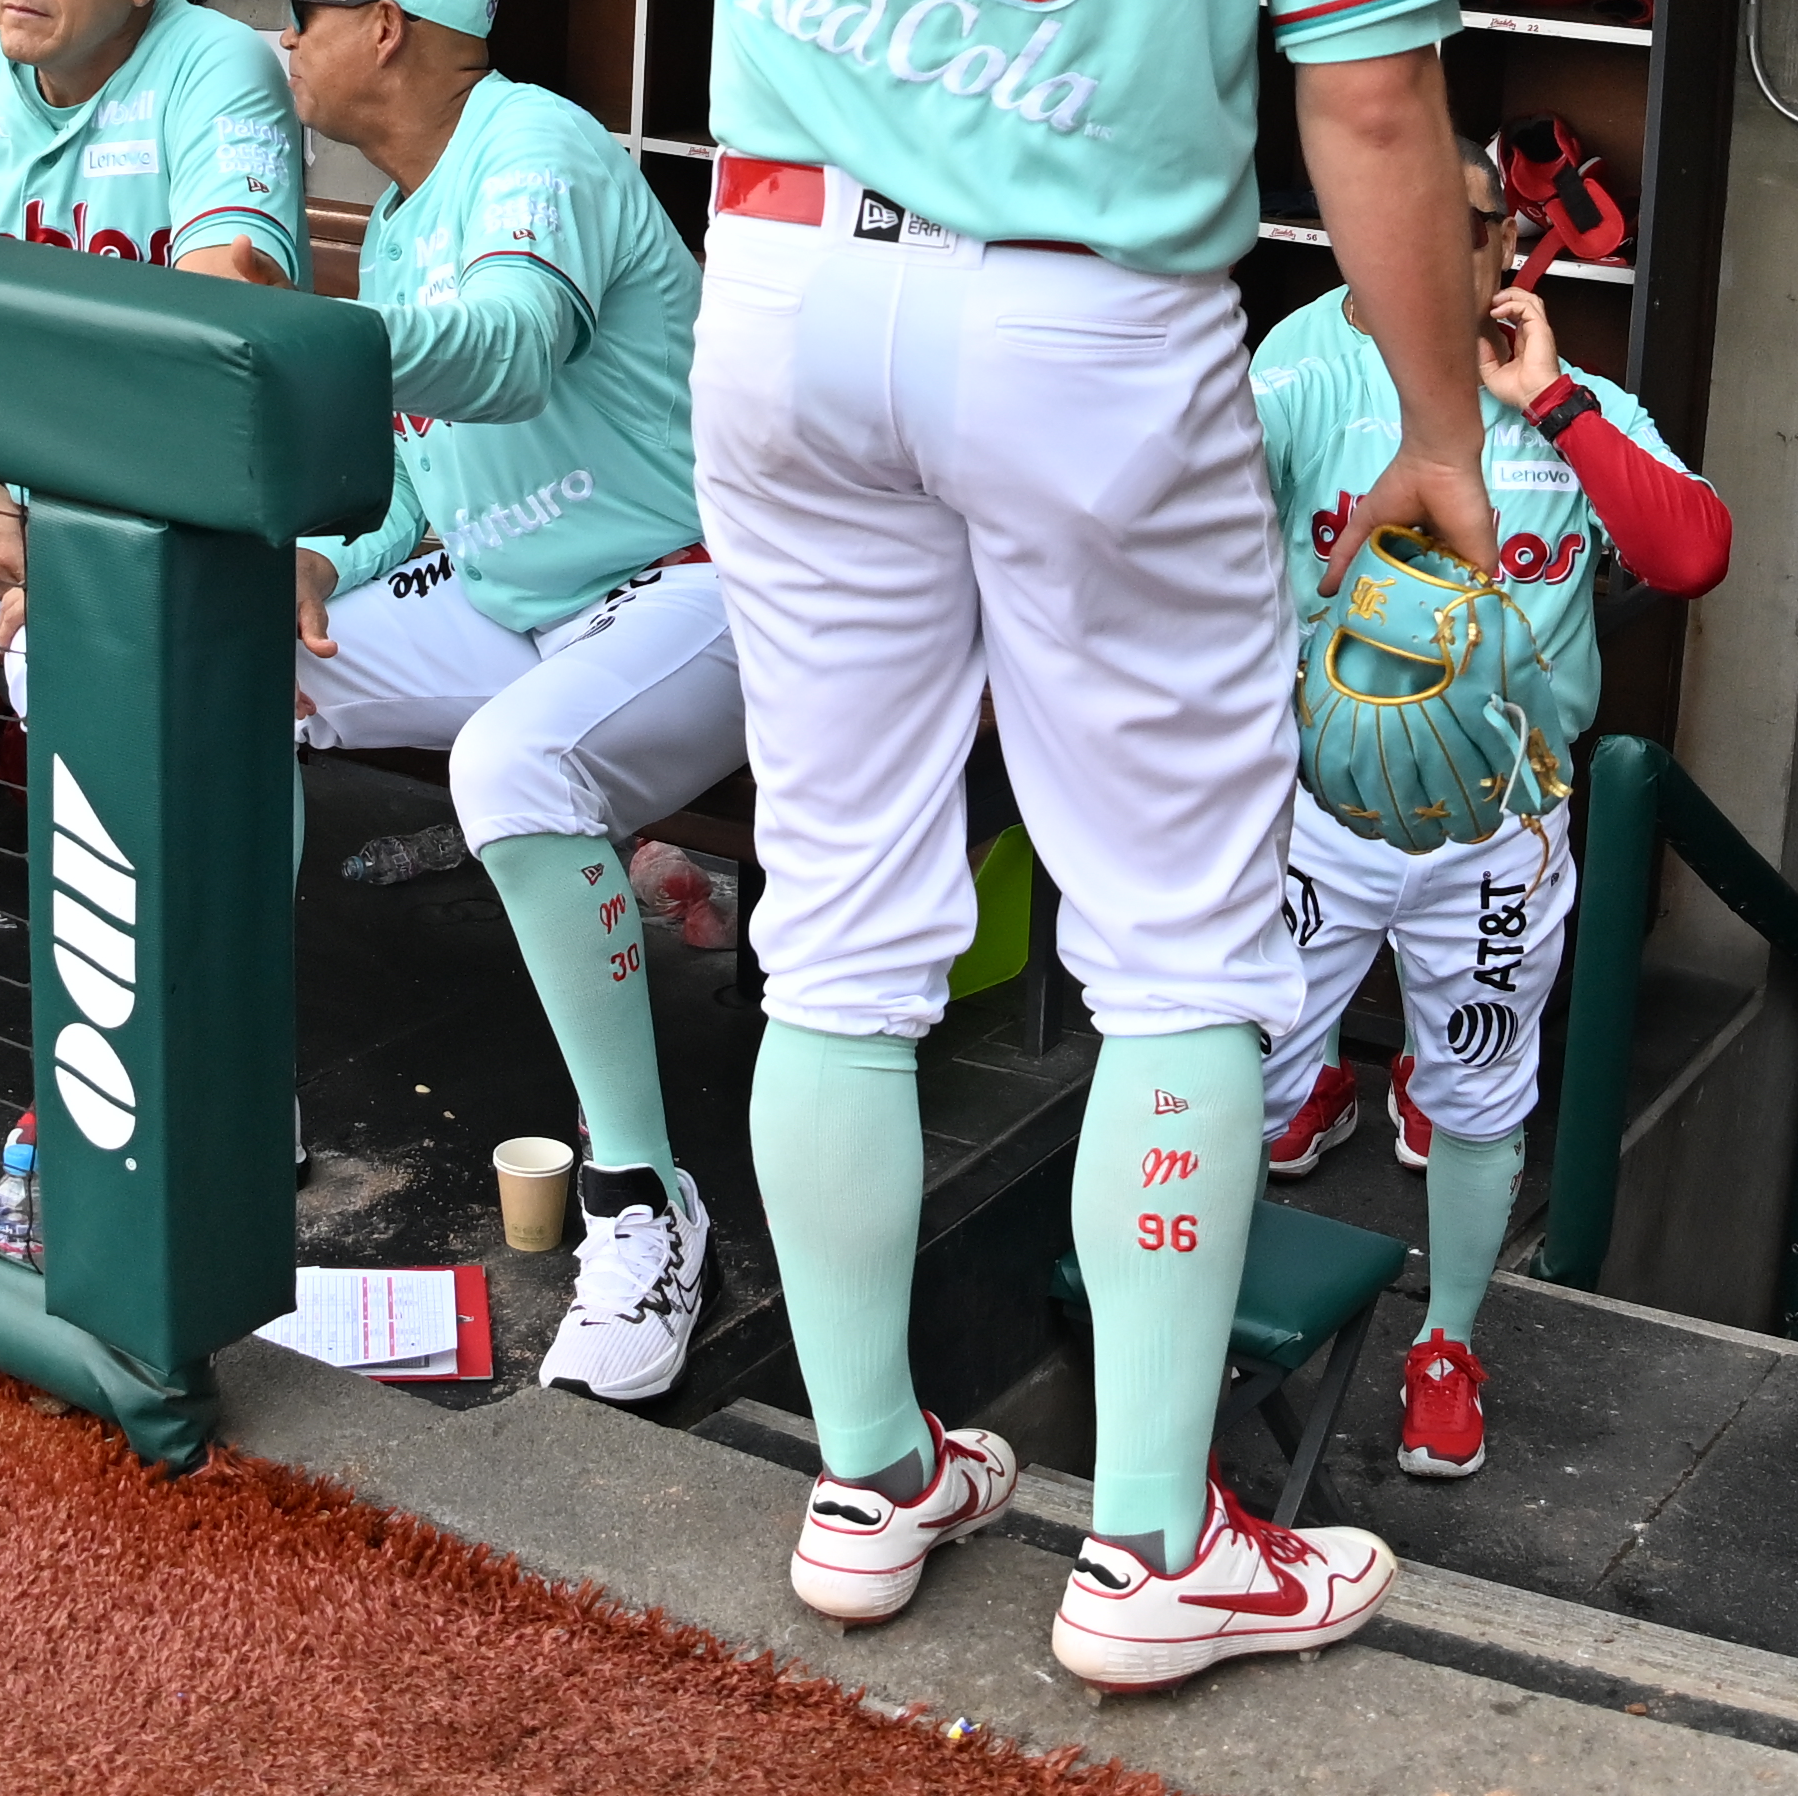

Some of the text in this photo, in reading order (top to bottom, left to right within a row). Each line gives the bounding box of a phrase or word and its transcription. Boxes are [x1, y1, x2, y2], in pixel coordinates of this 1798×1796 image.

[1526, 24, 1540, 33] 22
[1305, 233, 1319, 242] 56
[1472, 879, 1527, 994] AT&T
[610, 942, 641, 983] 30
[1136, 1212, 1199, 1253] 96
